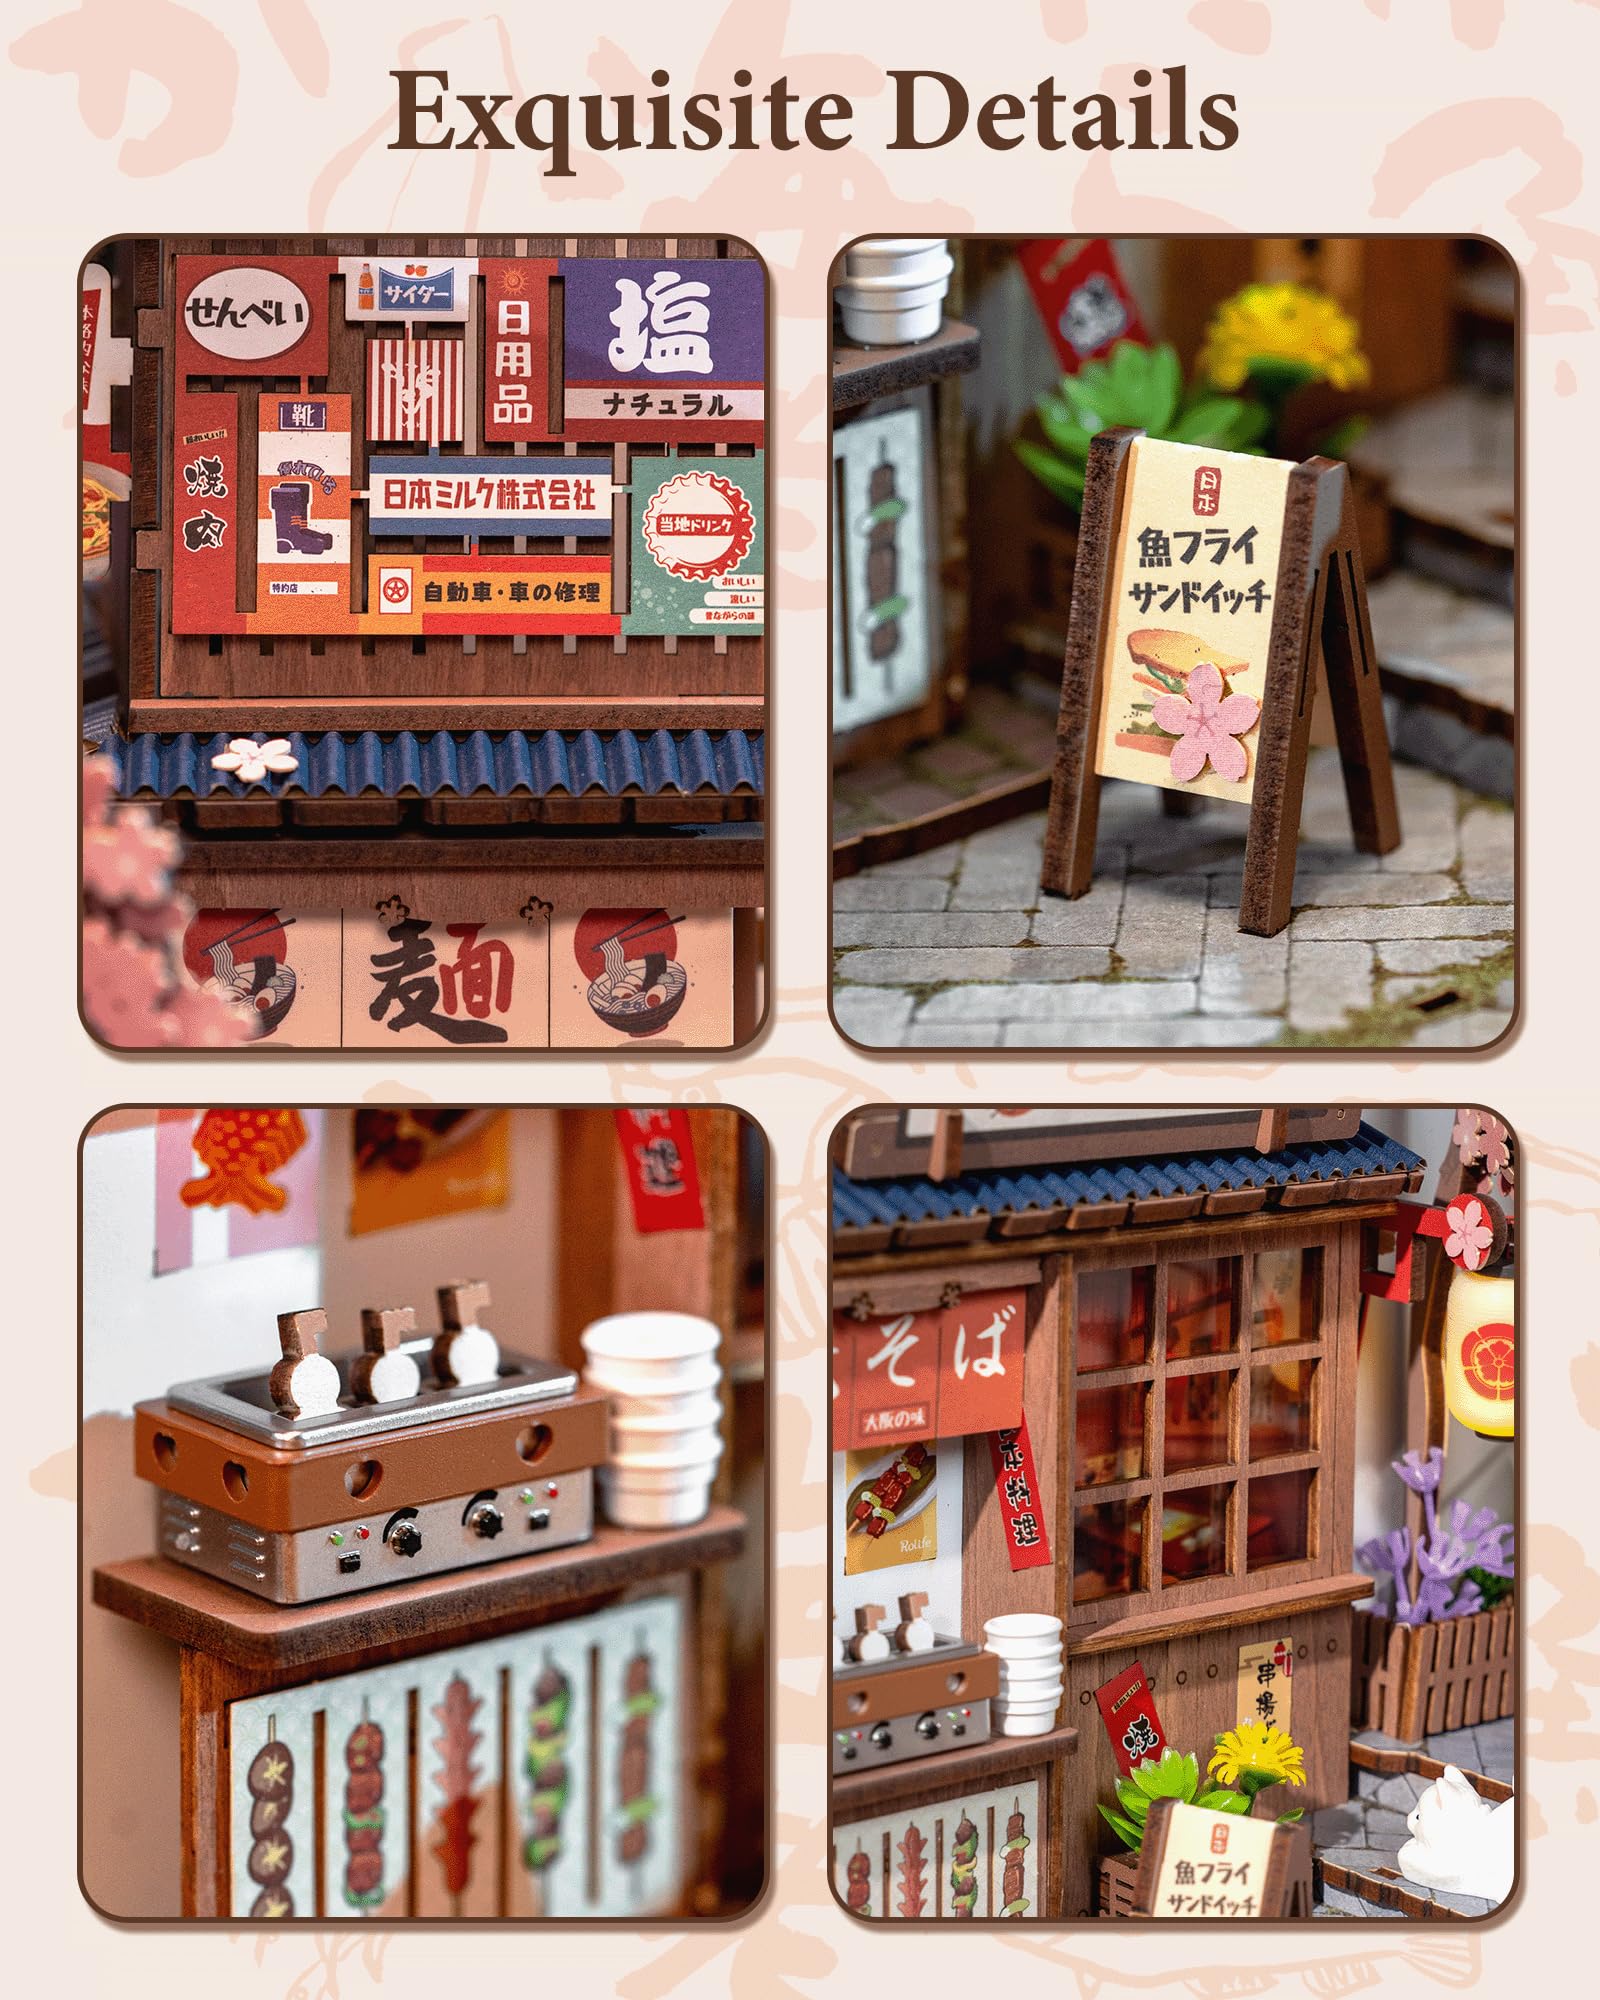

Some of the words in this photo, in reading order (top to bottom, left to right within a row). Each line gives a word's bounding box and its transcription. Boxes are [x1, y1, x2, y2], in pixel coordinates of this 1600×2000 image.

[384, 285, 450, 304] サイダー
[186, 297, 304, 329] せんべい
[608, 271, 714, 374] 塩
[493, 300, 534, 424] 日用品
[292, 404, 315, 427] 靴
[603, 392, 734, 417] ナチュラル
[384, 477, 596, 511] 日本ミルク株式会社
[660, 516, 732, 533] 当地ドリンク
[1138, 525, 1259, 568] 魚フライ
[272, 583, 298, 593] 特約店
[424, 581, 601, 603] 自動車・車の修理
[1128, 579, 1272, 615] サンドイッチ
[833, 1304, 1017, 1399] そば
[999, 1429, 1041, 1547] 本料理
[1175, 1860, 1251, 1886] 魚フライ
[1168, 1895, 1257, 1916] サンドイッチ
